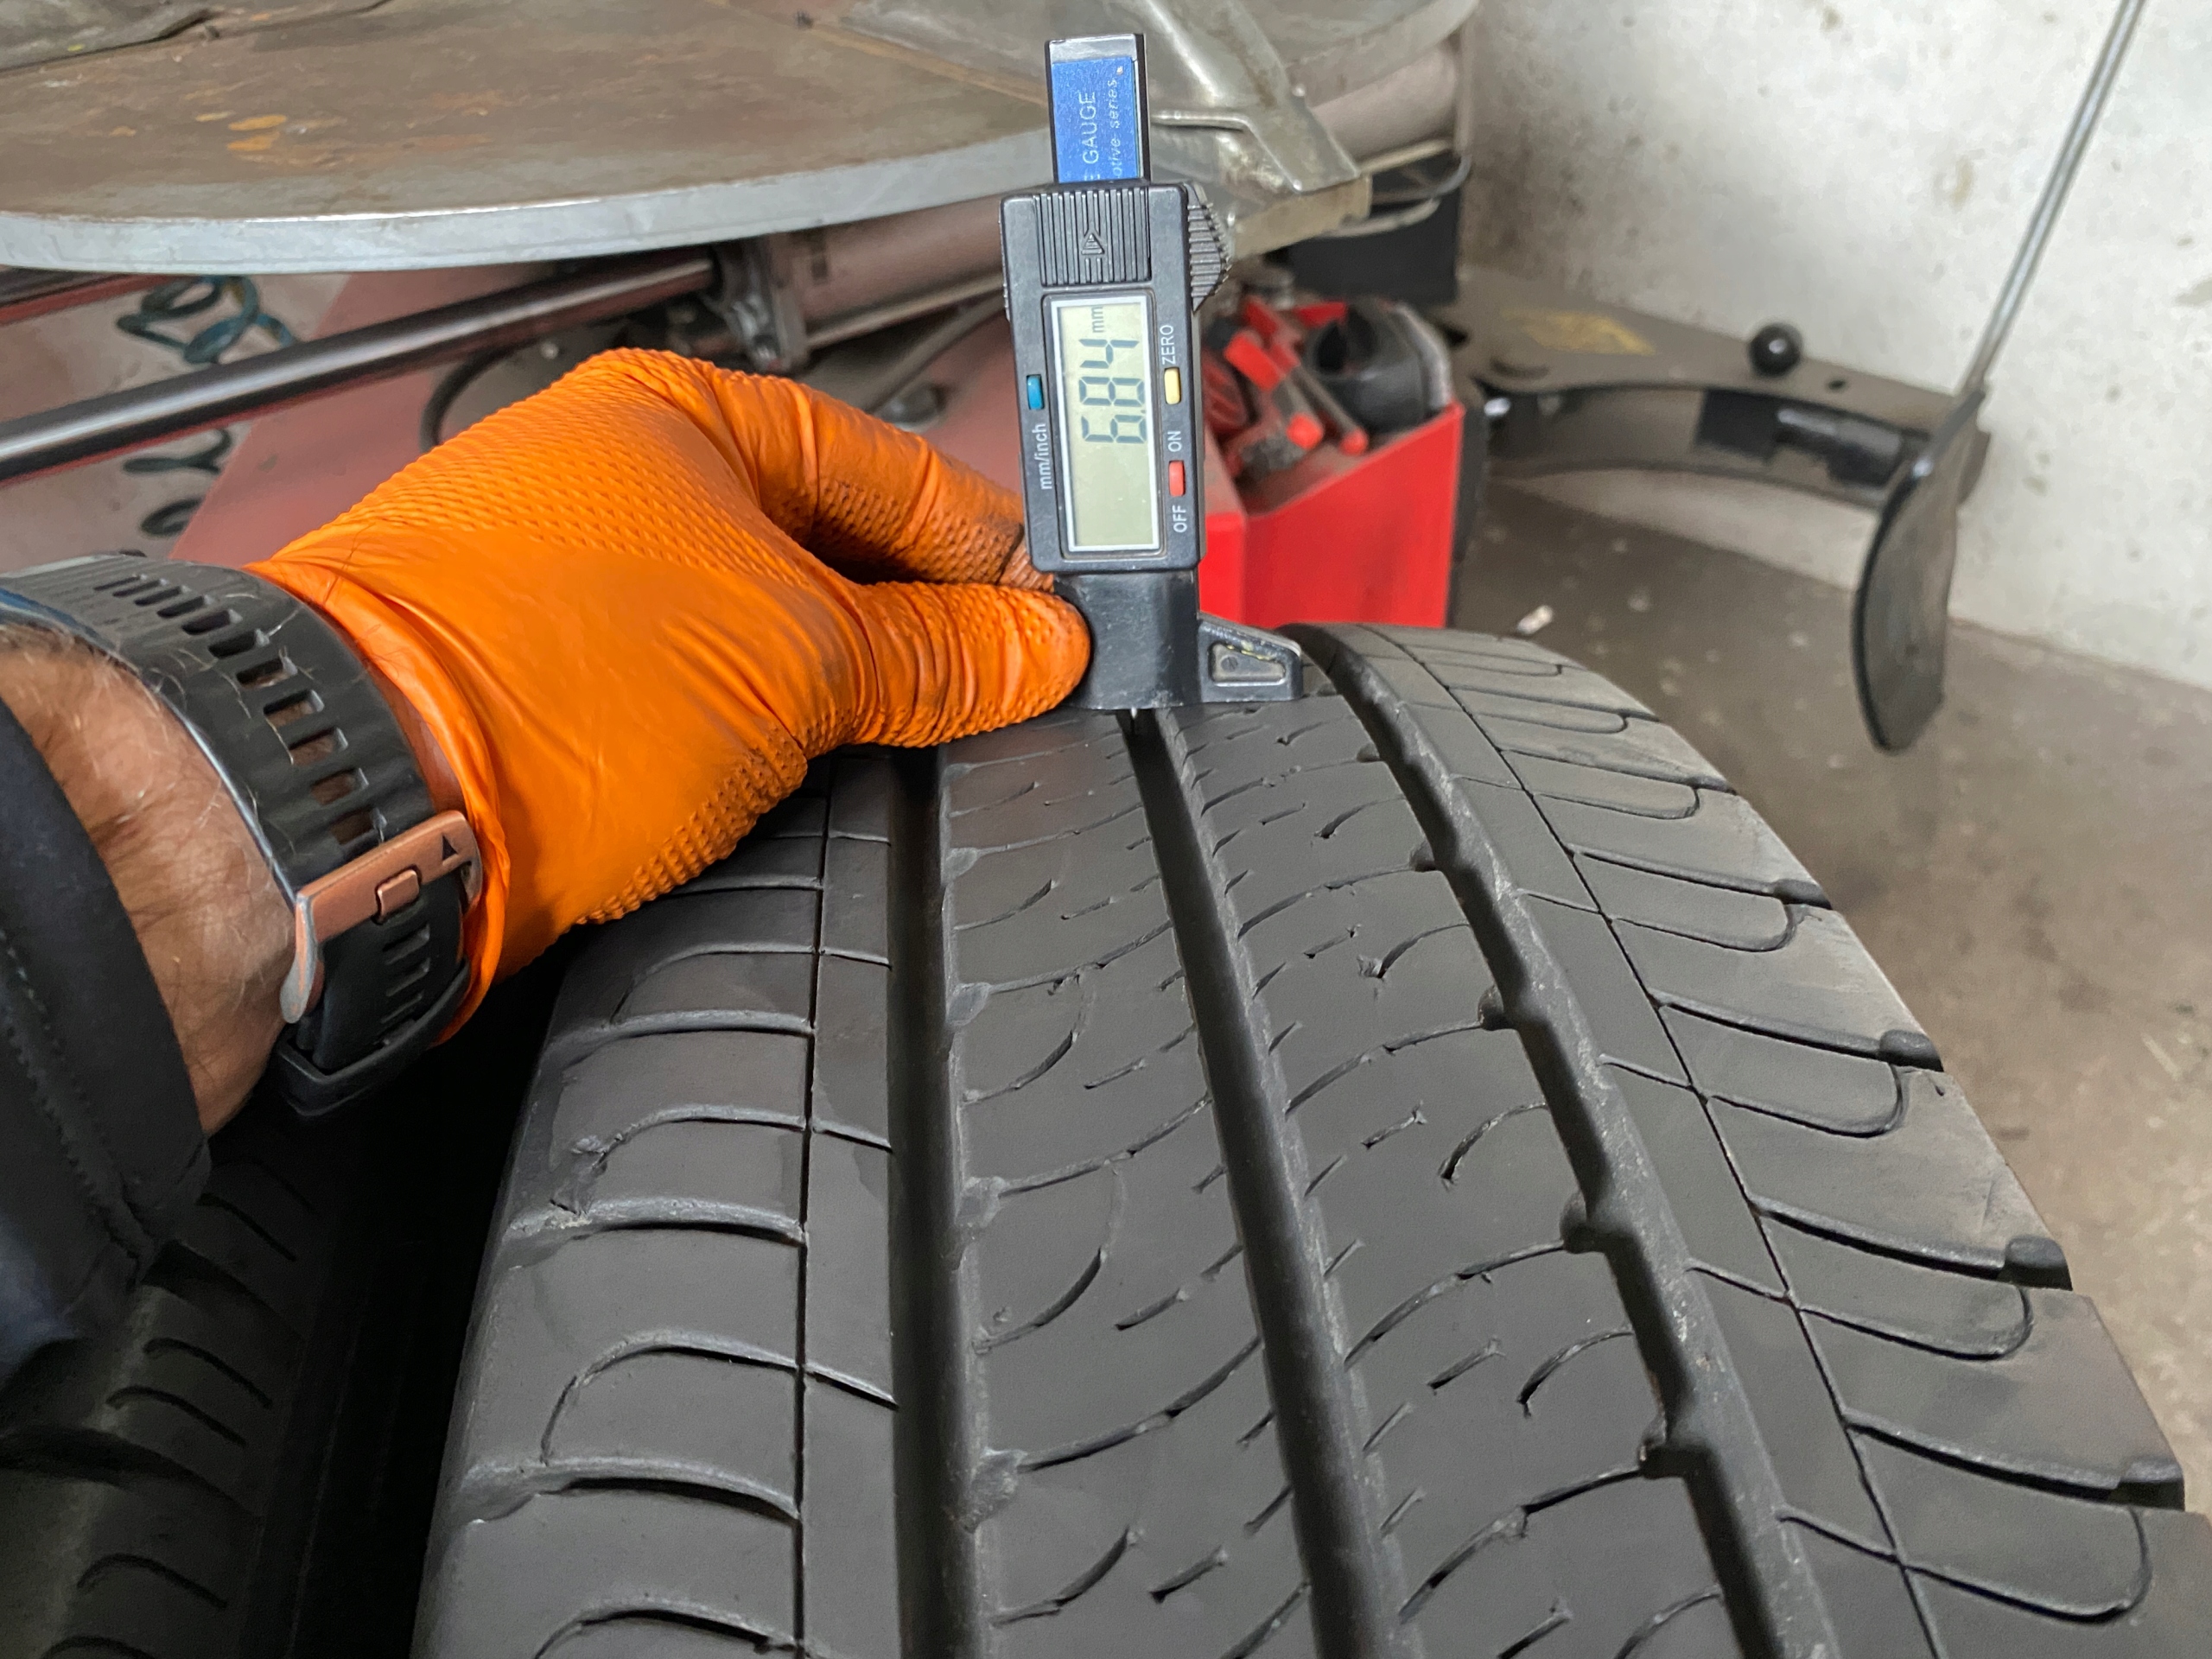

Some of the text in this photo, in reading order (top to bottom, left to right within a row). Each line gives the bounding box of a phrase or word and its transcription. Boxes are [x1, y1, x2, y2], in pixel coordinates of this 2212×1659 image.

[1079, 91, 1099, 165] GAUGE
[1108, 79, 1121, 129] series
[1160, 324, 1176, 365] ZERO
[1078, 306, 1147, 444] 6.84 mm
[1032, 423, 1052, 490] mm/inch
[1166, 430, 1182, 452] ON
[1172, 505, 1187, 533] OFF
